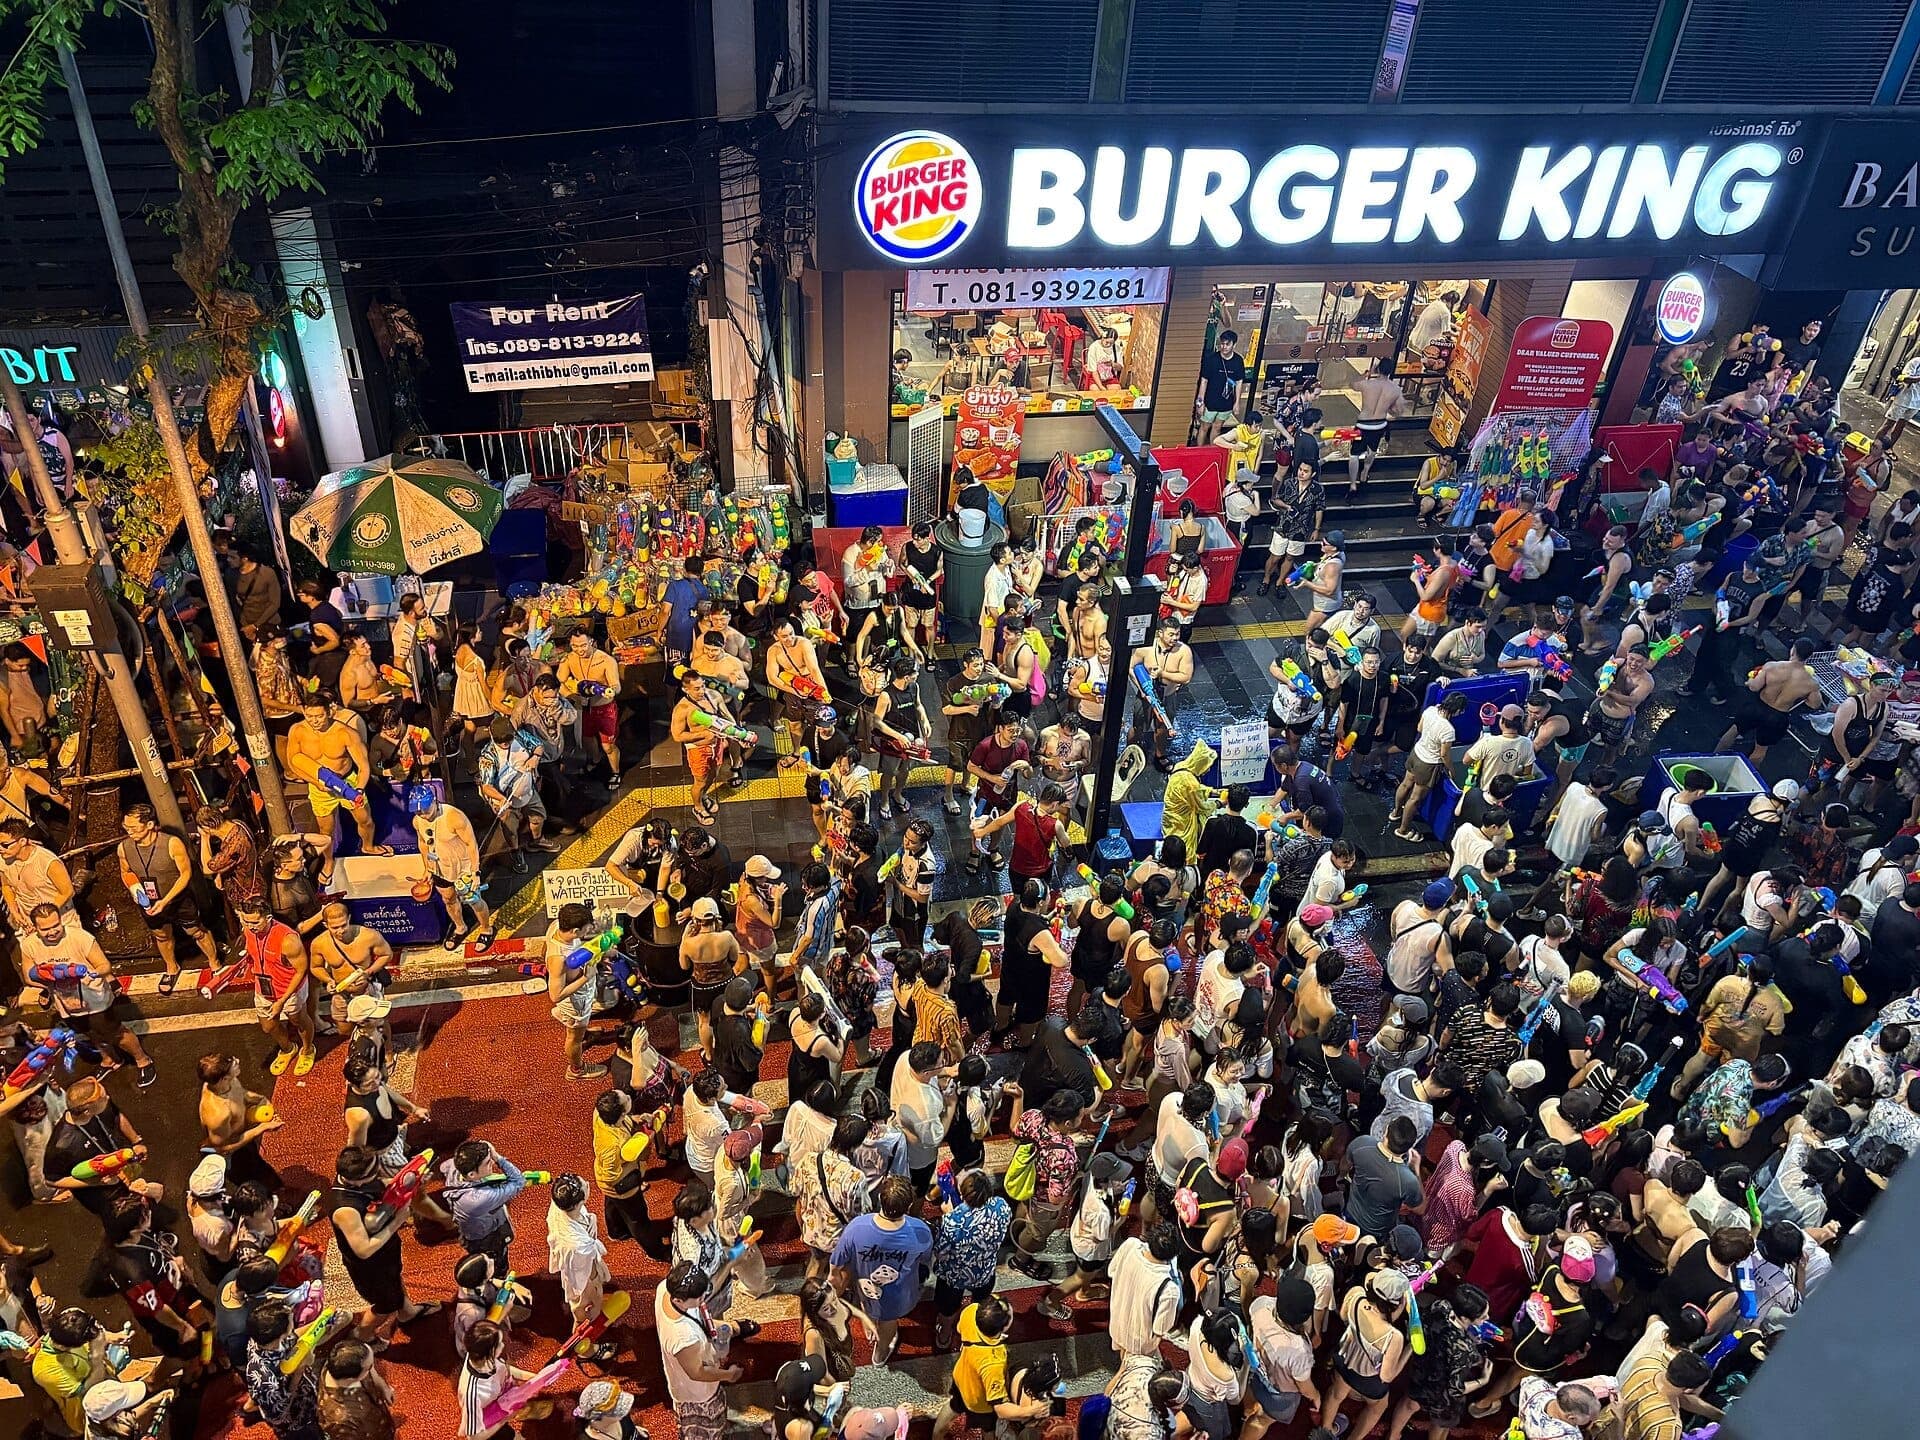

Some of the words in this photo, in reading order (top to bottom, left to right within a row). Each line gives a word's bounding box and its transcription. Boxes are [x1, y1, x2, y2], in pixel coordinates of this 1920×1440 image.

[871, 158, 966, 200] BURGER
[1007, 144, 1477, 248] BURGER
[1498, 143, 1782, 242] KING
[873, 181, 968, 233] KING
[932, 282, 957, 305] T.
[968, 277, 1146, 304] 081-9392681
[1664, 290, 1703, 307] BURGER
[489, 306, 536, 326] For
[546, 301, 610, 322] Rent
[1661, 303, 1700, 324] KING
[1552, 334, 1577, 343] KING
[1554, 328, 1578, 336] BURGER
[1536, 350, 1560, 358] VALUED
[468, 361, 651, 384] E-mail:athibhu@gmail.com
[1517, 375, 1537, 383] WILL
[1538, 376, 1549, 384] BE
[1549, 377, 1584, 385] CLOSING
[1730, 361, 1750, 377] 23
[410, 523, 465, 549] โรงรับจำนำ
